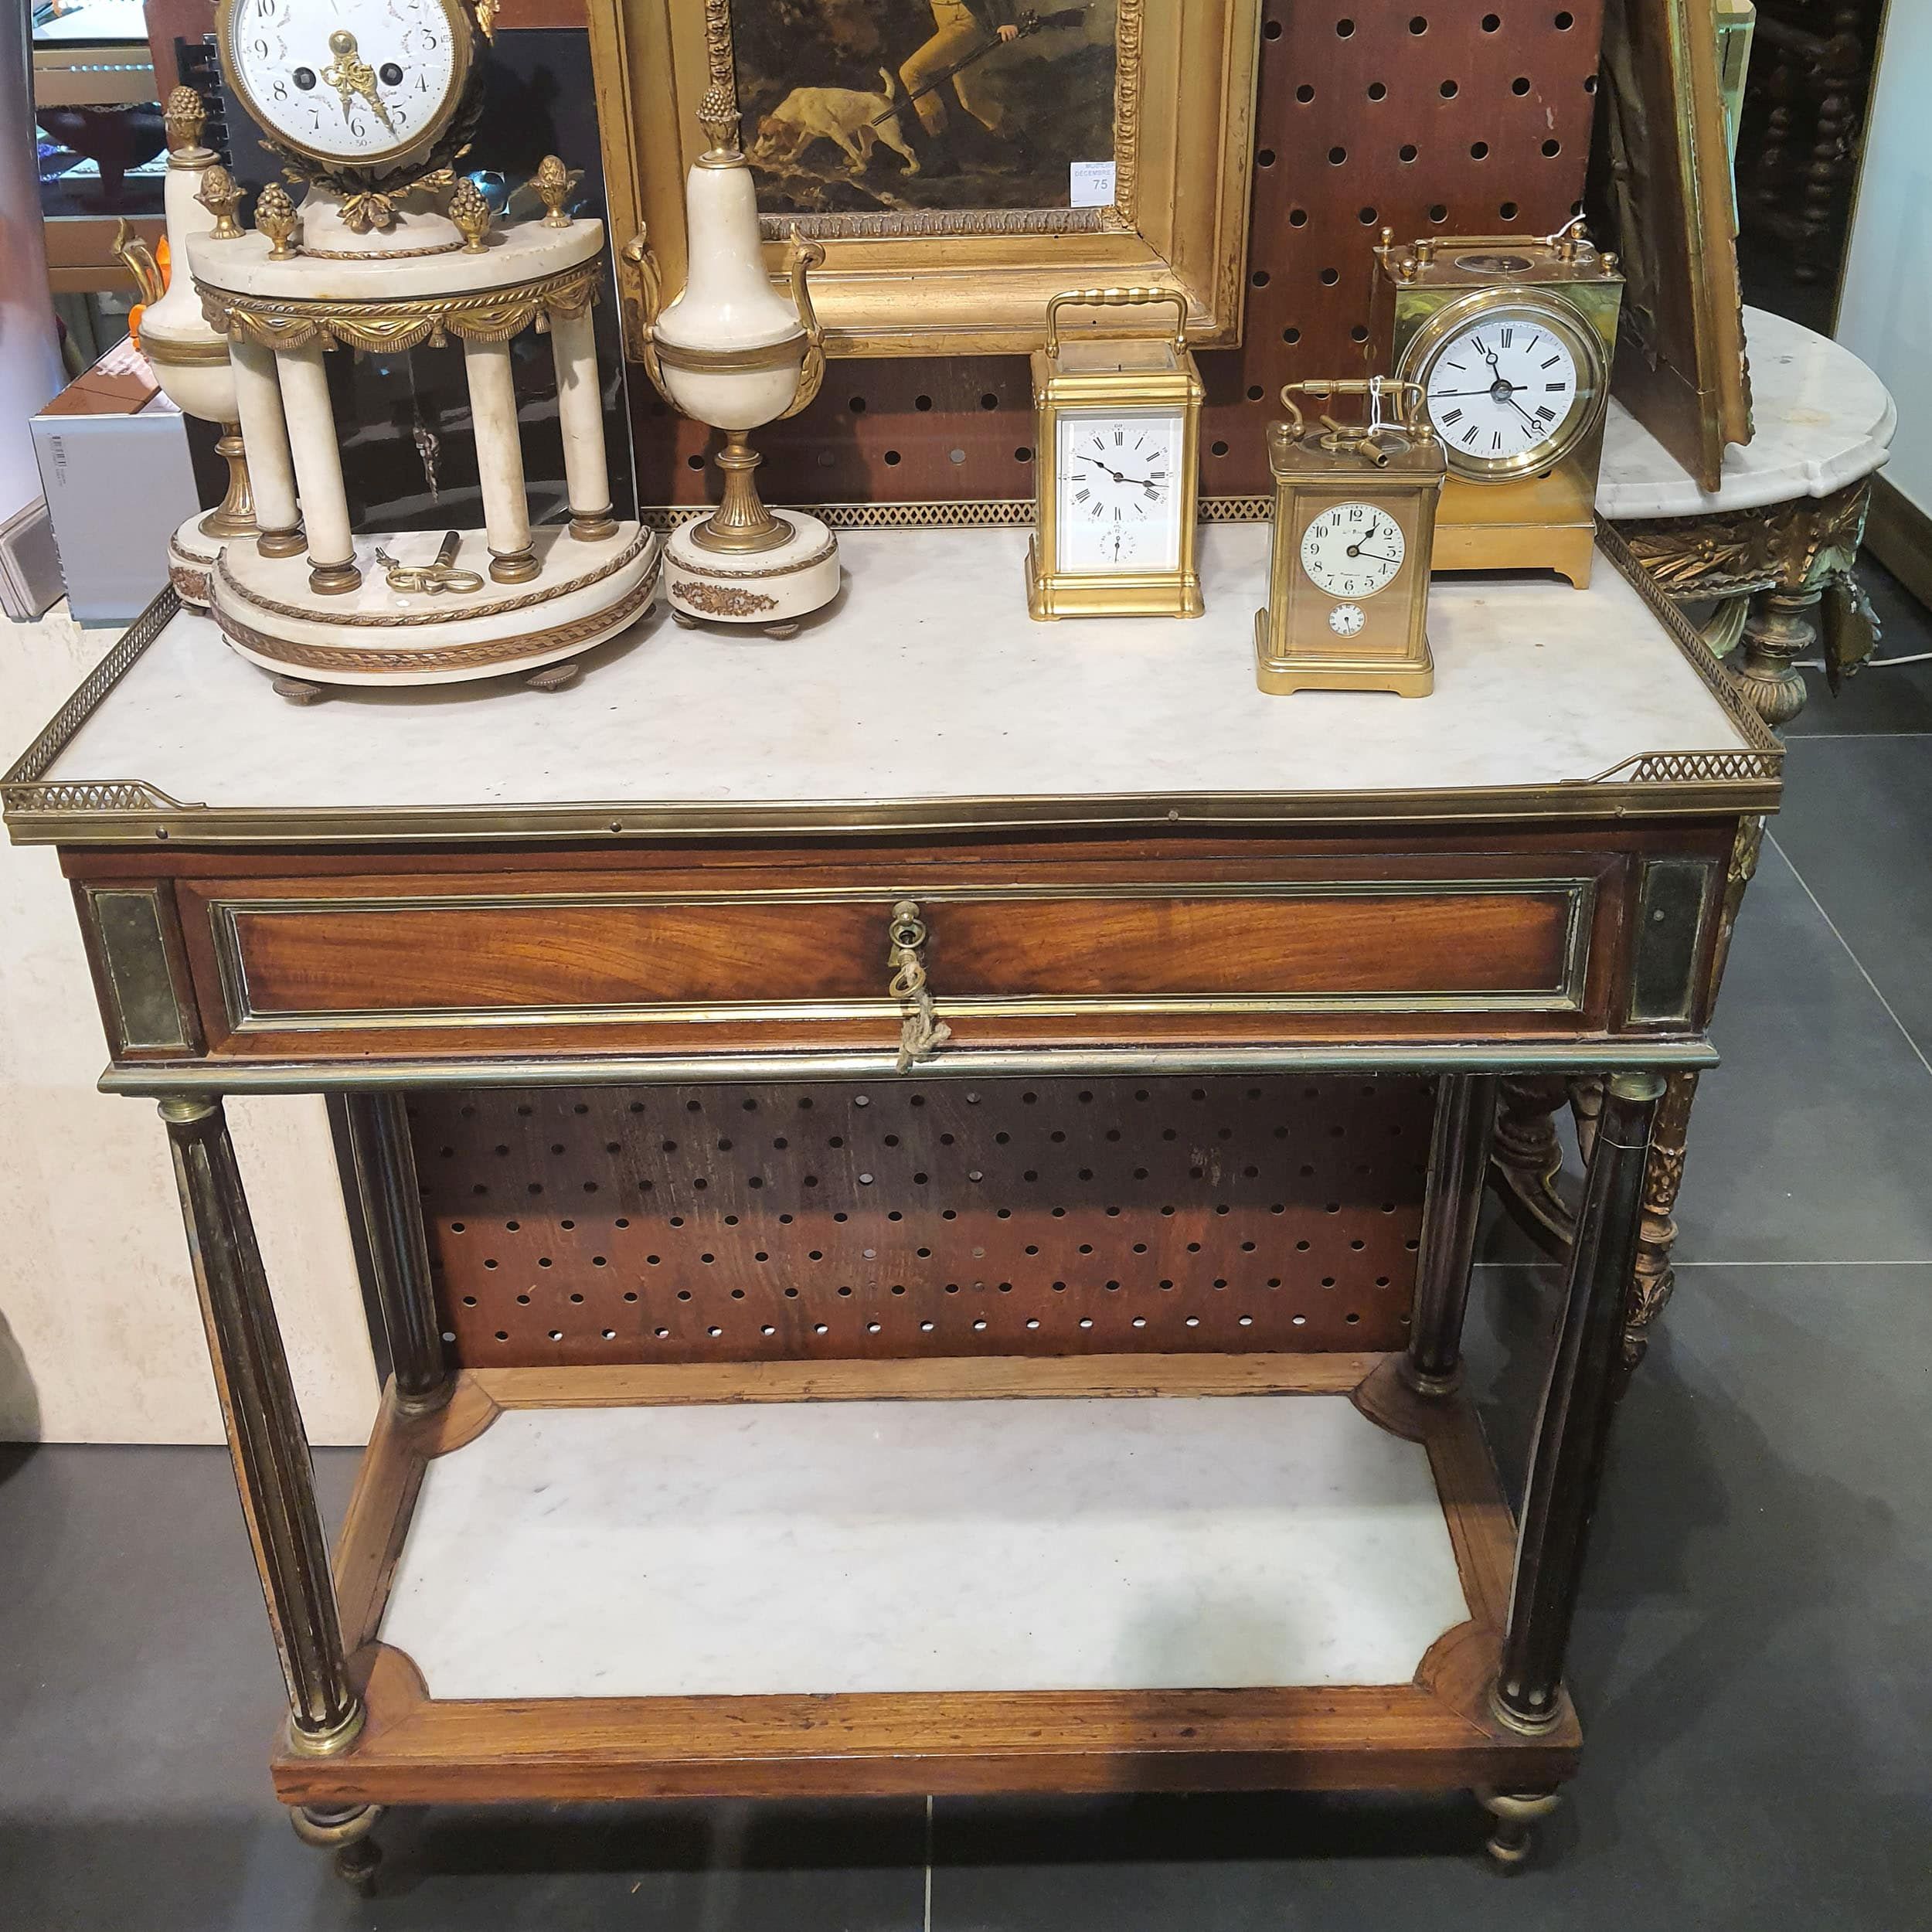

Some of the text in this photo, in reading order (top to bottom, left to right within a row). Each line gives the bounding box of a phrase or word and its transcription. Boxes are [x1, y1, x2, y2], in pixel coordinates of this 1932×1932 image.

[257, 0, 275, 17] 10
[421, 29, 437, 50] 3
[254, 39, 268, 60] 9
[415, 73, 429, 92] 4
[273, 80, 287, 101] 8
[392, 101, 406, 124] 5
[308, 109, 319, 129] 7
[351, 117, 366, 137] 6
[1093, 179, 1108, 190] 75
[1332, 514, 1341, 526] 11
[1349, 509, 1363, 522] 12
[1372, 515, 1376, 527] 1
[1315, 526, 1328, 538] 10
[1310, 543, 1320, 555] 9
[1313, 561, 1322, 573] 8
[1378, 563, 1388, 575] 4
[1327, 574, 1335, 586] 7
[1344, 580, 1354, 591] 6
[1364, 576, 1374, 587] 5
